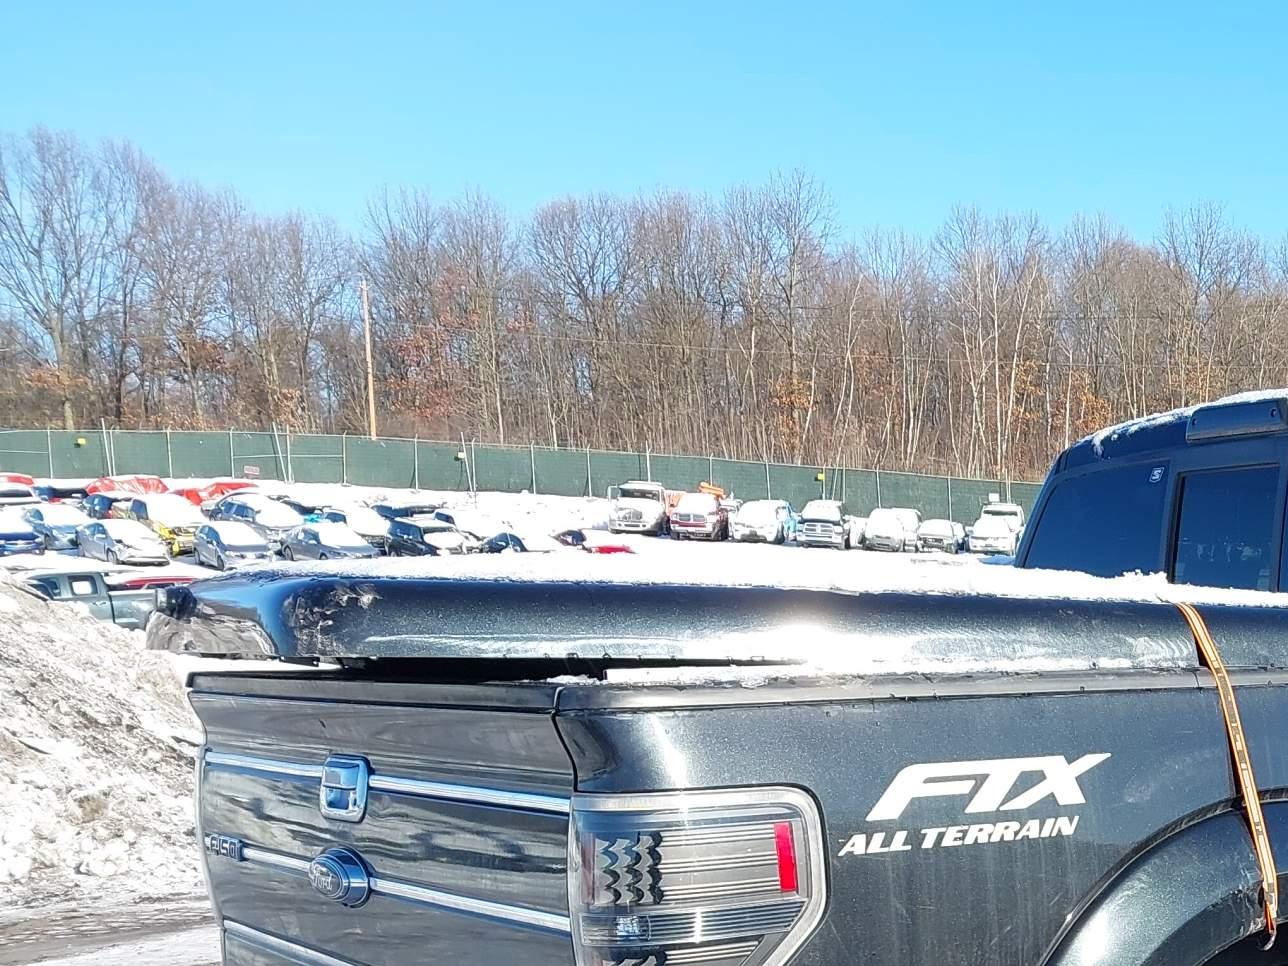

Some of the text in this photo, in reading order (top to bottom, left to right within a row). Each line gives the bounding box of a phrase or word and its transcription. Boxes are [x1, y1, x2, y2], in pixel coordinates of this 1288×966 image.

[866, 752, 1112, 822] FTX
[837, 815, 1080, 857] ALL TERRAIN
[312, 862, 334, 891] Ford
